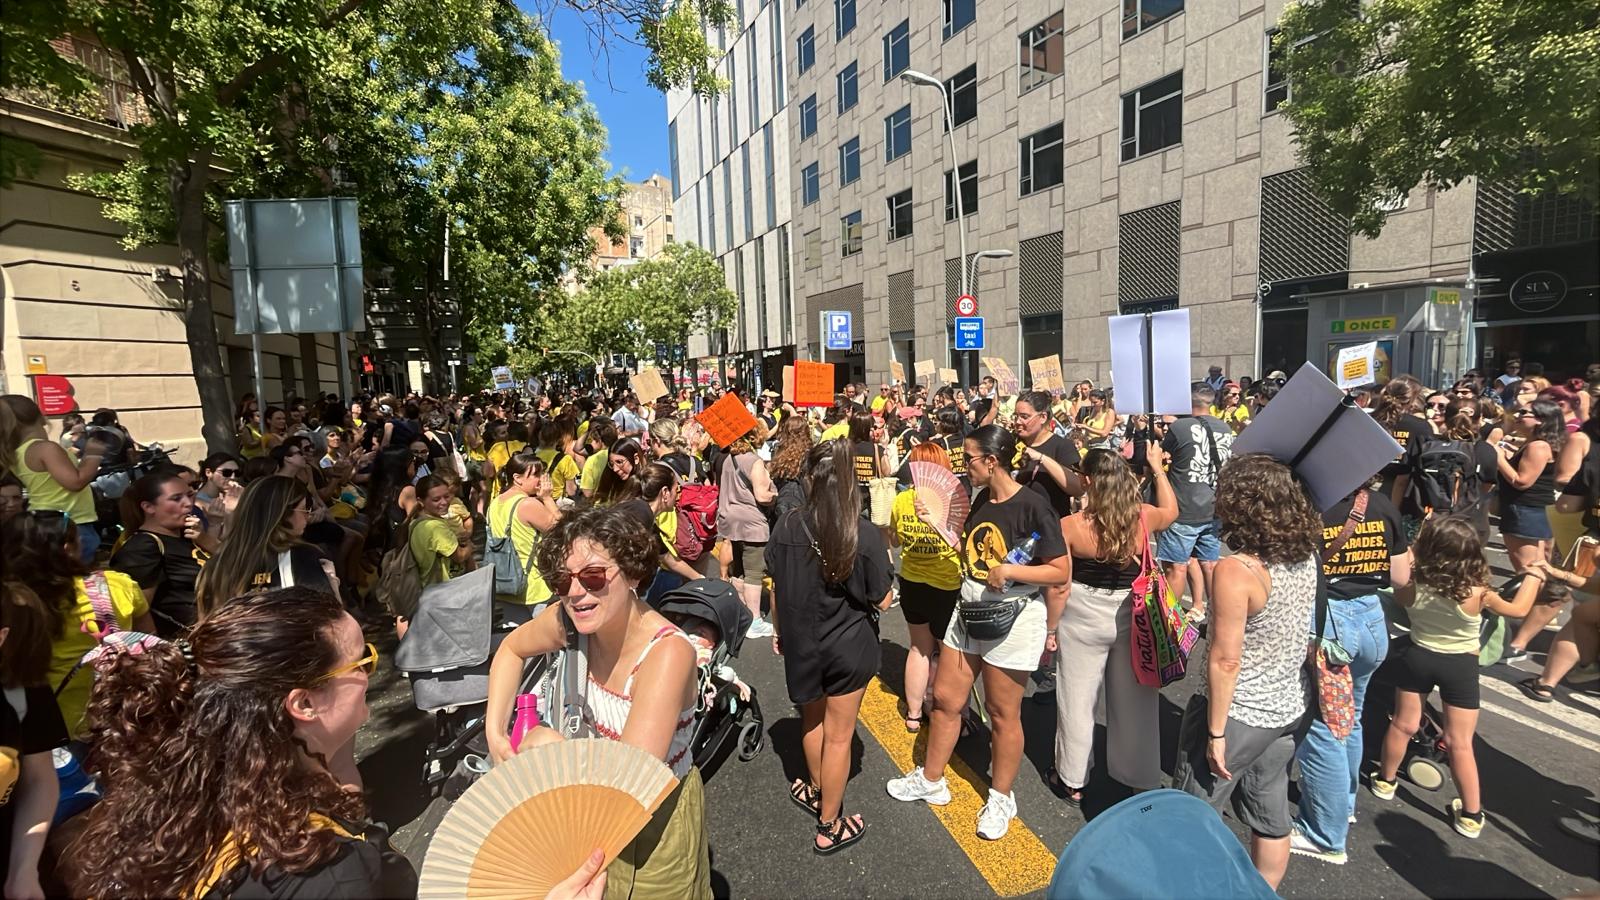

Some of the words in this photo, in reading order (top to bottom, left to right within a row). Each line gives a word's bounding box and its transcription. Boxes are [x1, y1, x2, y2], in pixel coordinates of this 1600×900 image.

[1439, 293, 1459, 301] ONCE
[961, 302, 973, 310] 30
[832, 315, 847, 332] P
[1349, 319, 1391, 331] ONCE
[902, 514, 915, 523] ENS
[1355, 520, 1385, 534] OLIEN
[1345, 549, 1388, 562] TROBEN
[1322, 562, 1390, 575] GANITZADES
[1135, 611, 1156, 673] natura
